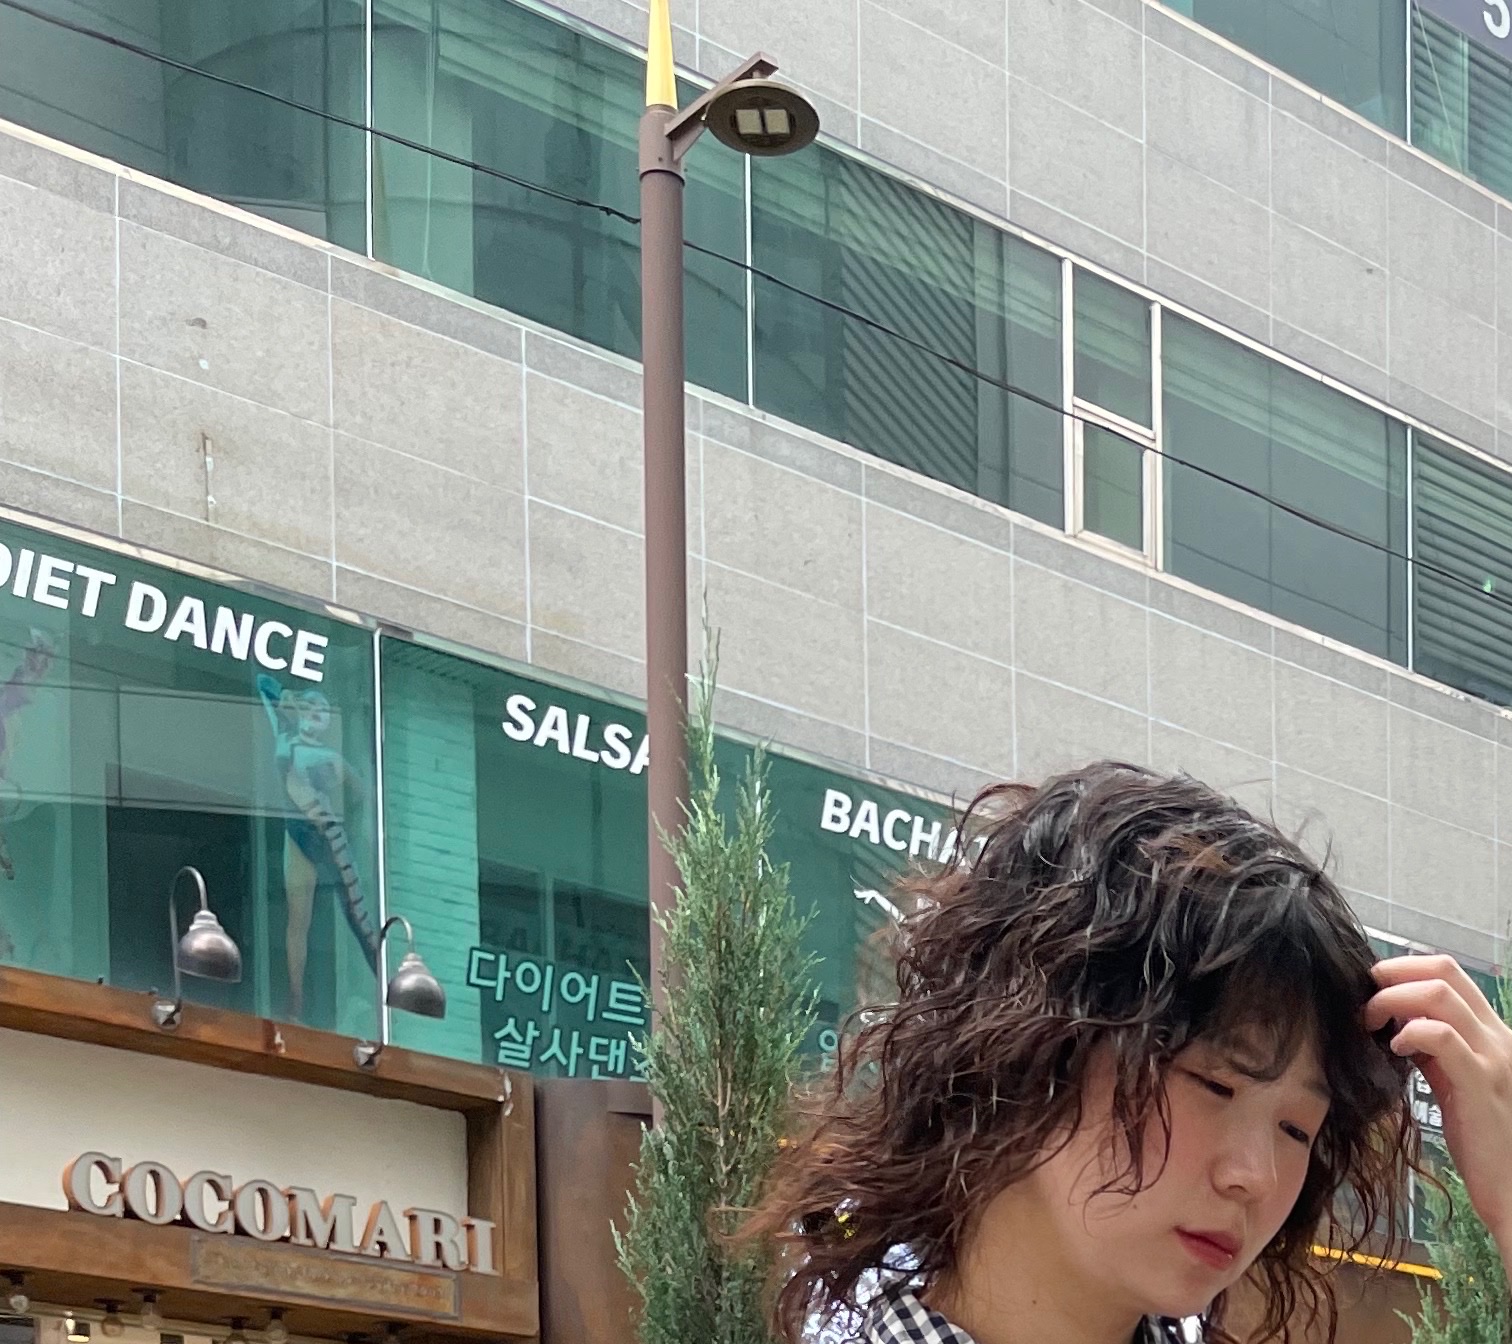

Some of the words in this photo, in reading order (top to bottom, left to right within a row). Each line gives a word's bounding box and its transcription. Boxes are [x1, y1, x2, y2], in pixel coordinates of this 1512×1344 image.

[125, 580, 329, 681] DANCE
[468, 948, 645, 1026] 다이어트
[62, 1151, 500, 1277] COCOMARI
